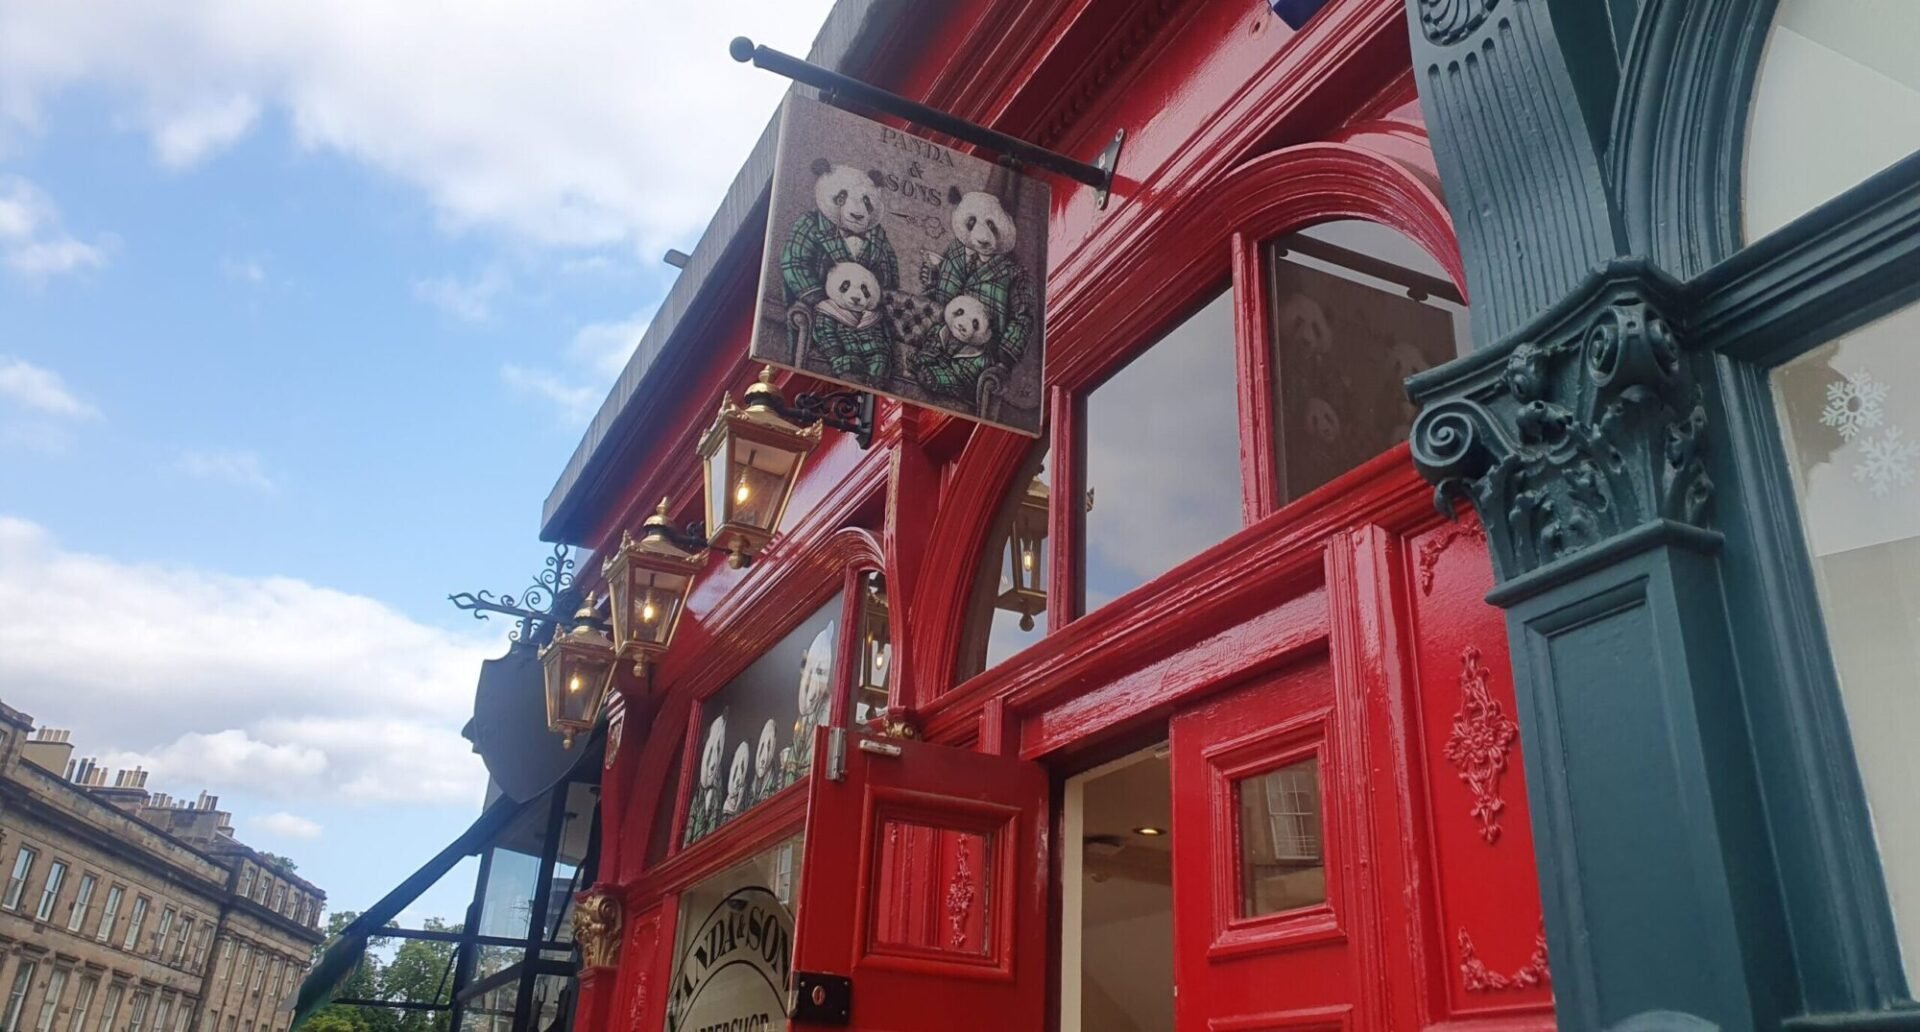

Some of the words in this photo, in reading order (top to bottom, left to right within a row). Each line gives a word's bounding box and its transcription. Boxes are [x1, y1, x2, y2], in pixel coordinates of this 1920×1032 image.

[881, 128, 954, 168] PANDA
[908, 161, 924, 179] &
[886, 174, 942, 207] SONS
[736, 912, 746, 939] &
[745, 906, 791, 992] SON
